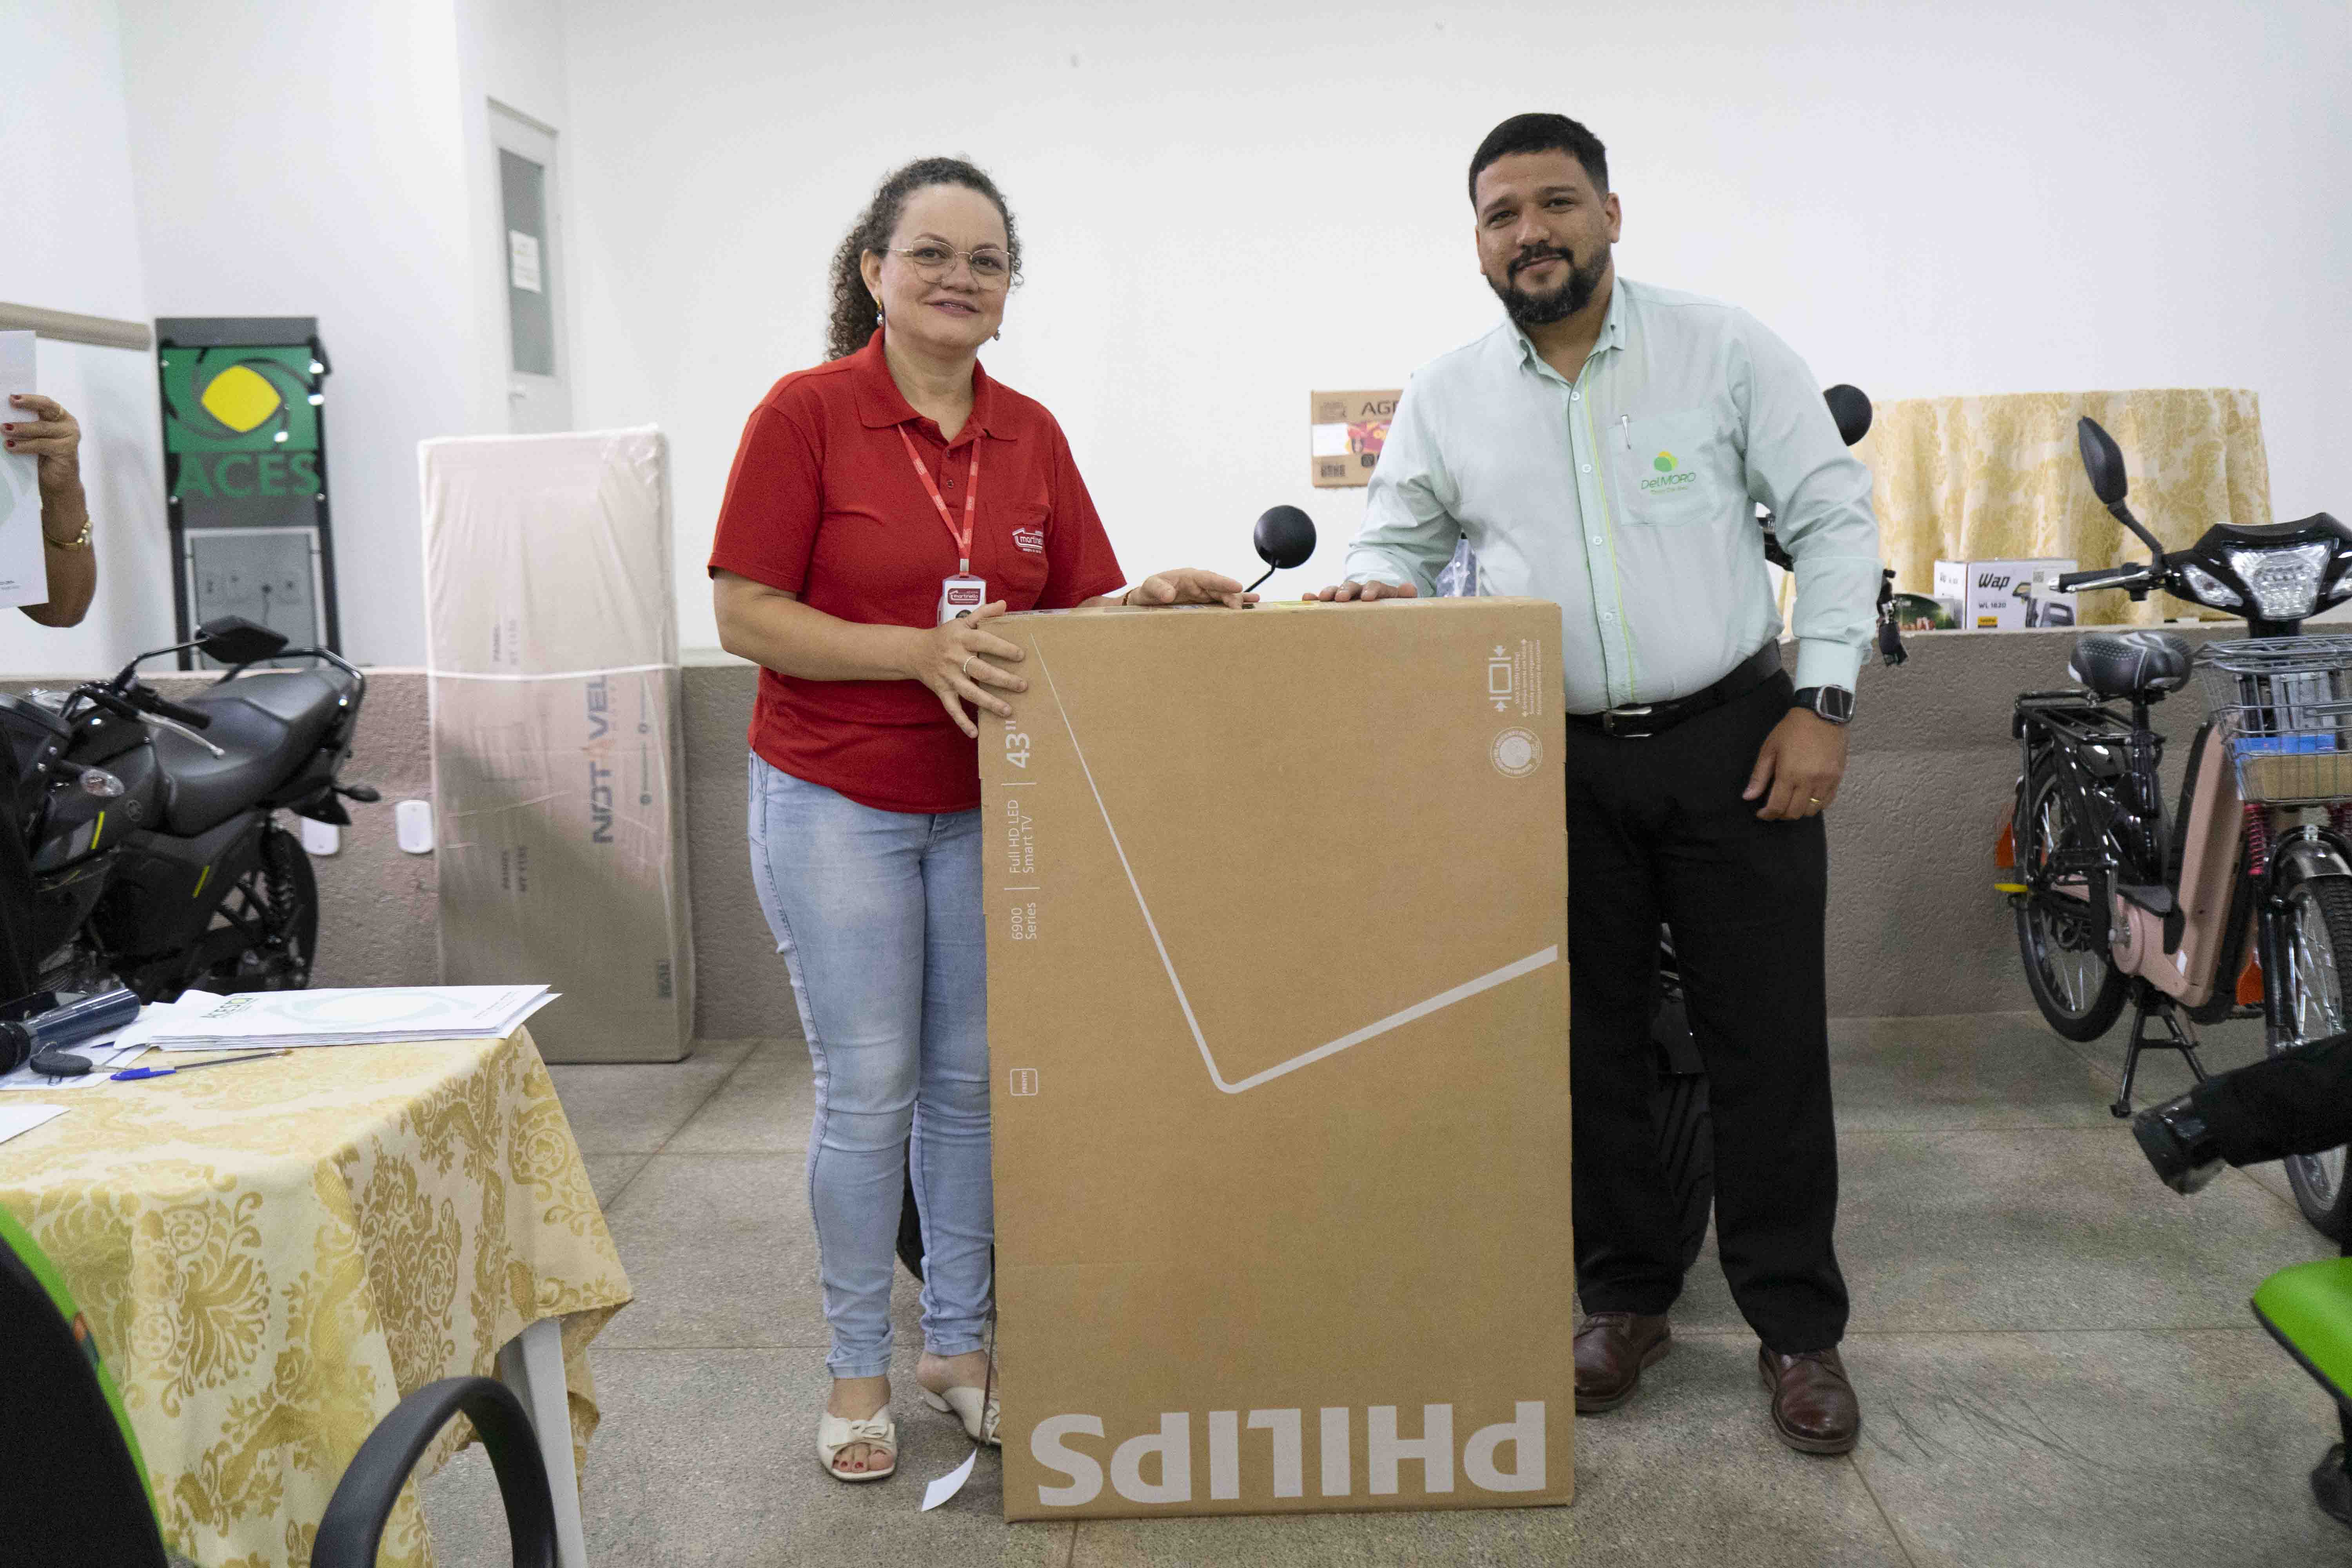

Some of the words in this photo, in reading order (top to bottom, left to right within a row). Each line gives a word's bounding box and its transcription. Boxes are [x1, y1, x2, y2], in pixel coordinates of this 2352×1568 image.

[174, 453, 321, 498] ACES
[1978, 572, 2011, 591] Wap
[1004, 720, 1031, 769] 43"
[1007, 799, 1019, 824] LED
[1021, 815, 1033, 833] TV
[1008, 826, 1020, 848] HD
[1022, 835, 1034, 874] Smart
[1009, 850, 1021, 874] Full
[1011, 906, 1023, 941] 6900
[1025, 902, 1038, 941] Series
[1029, 1401, 1546, 1508] PHILIPS
